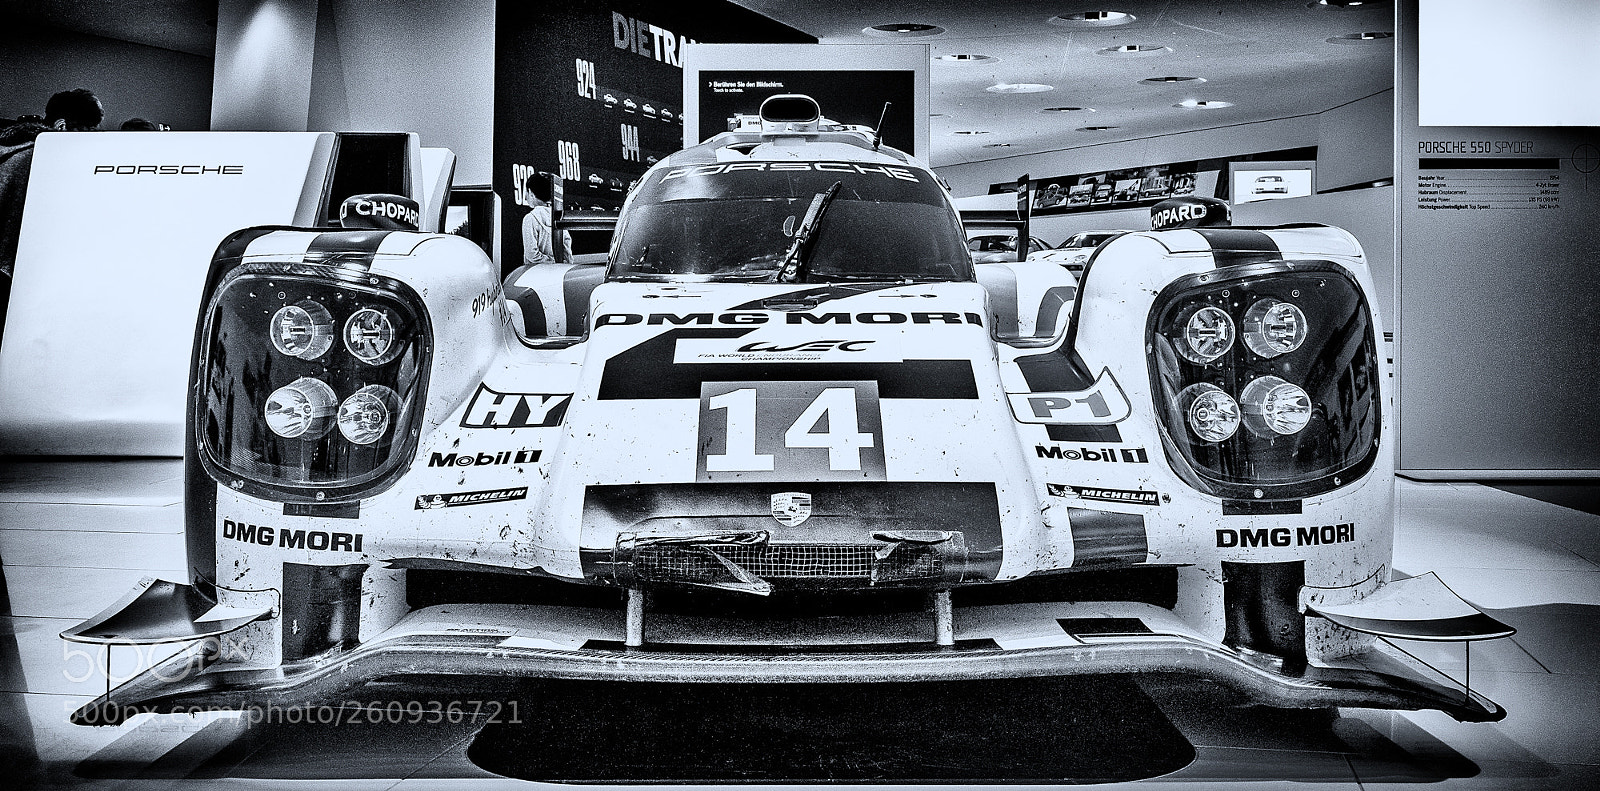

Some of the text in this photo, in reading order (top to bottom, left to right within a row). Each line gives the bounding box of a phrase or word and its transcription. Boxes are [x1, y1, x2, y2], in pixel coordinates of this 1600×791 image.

[576, 58, 597, 100] 924
[621, 123, 640, 163] 944
[1418, 141, 1534, 154] PORSCHE 550 SPYDER
[94, 165, 244, 175] PORSCHE
[557, 139, 581, 182] 968
[658, 162, 920, 184] PORSCHE
[472, 292, 486, 319] 919
[594, 311, 984, 331] DMG MORI
[736, 339, 876, 352] WEC
[465, 387, 570, 426] HY
[1027, 389, 1112, 418] P1
[705, 387, 875, 472] 14
[428, 450, 512, 468] Mobil
[1034, 445, 1118, 463] Mobil
[450, 488, 526, 503] MICHELIN
[1081, 489, 1157, 502] MICHELIN
[223, 519, 363, 553] DMG MORI
[1216, 522, 1355, 547] DMG MORI
